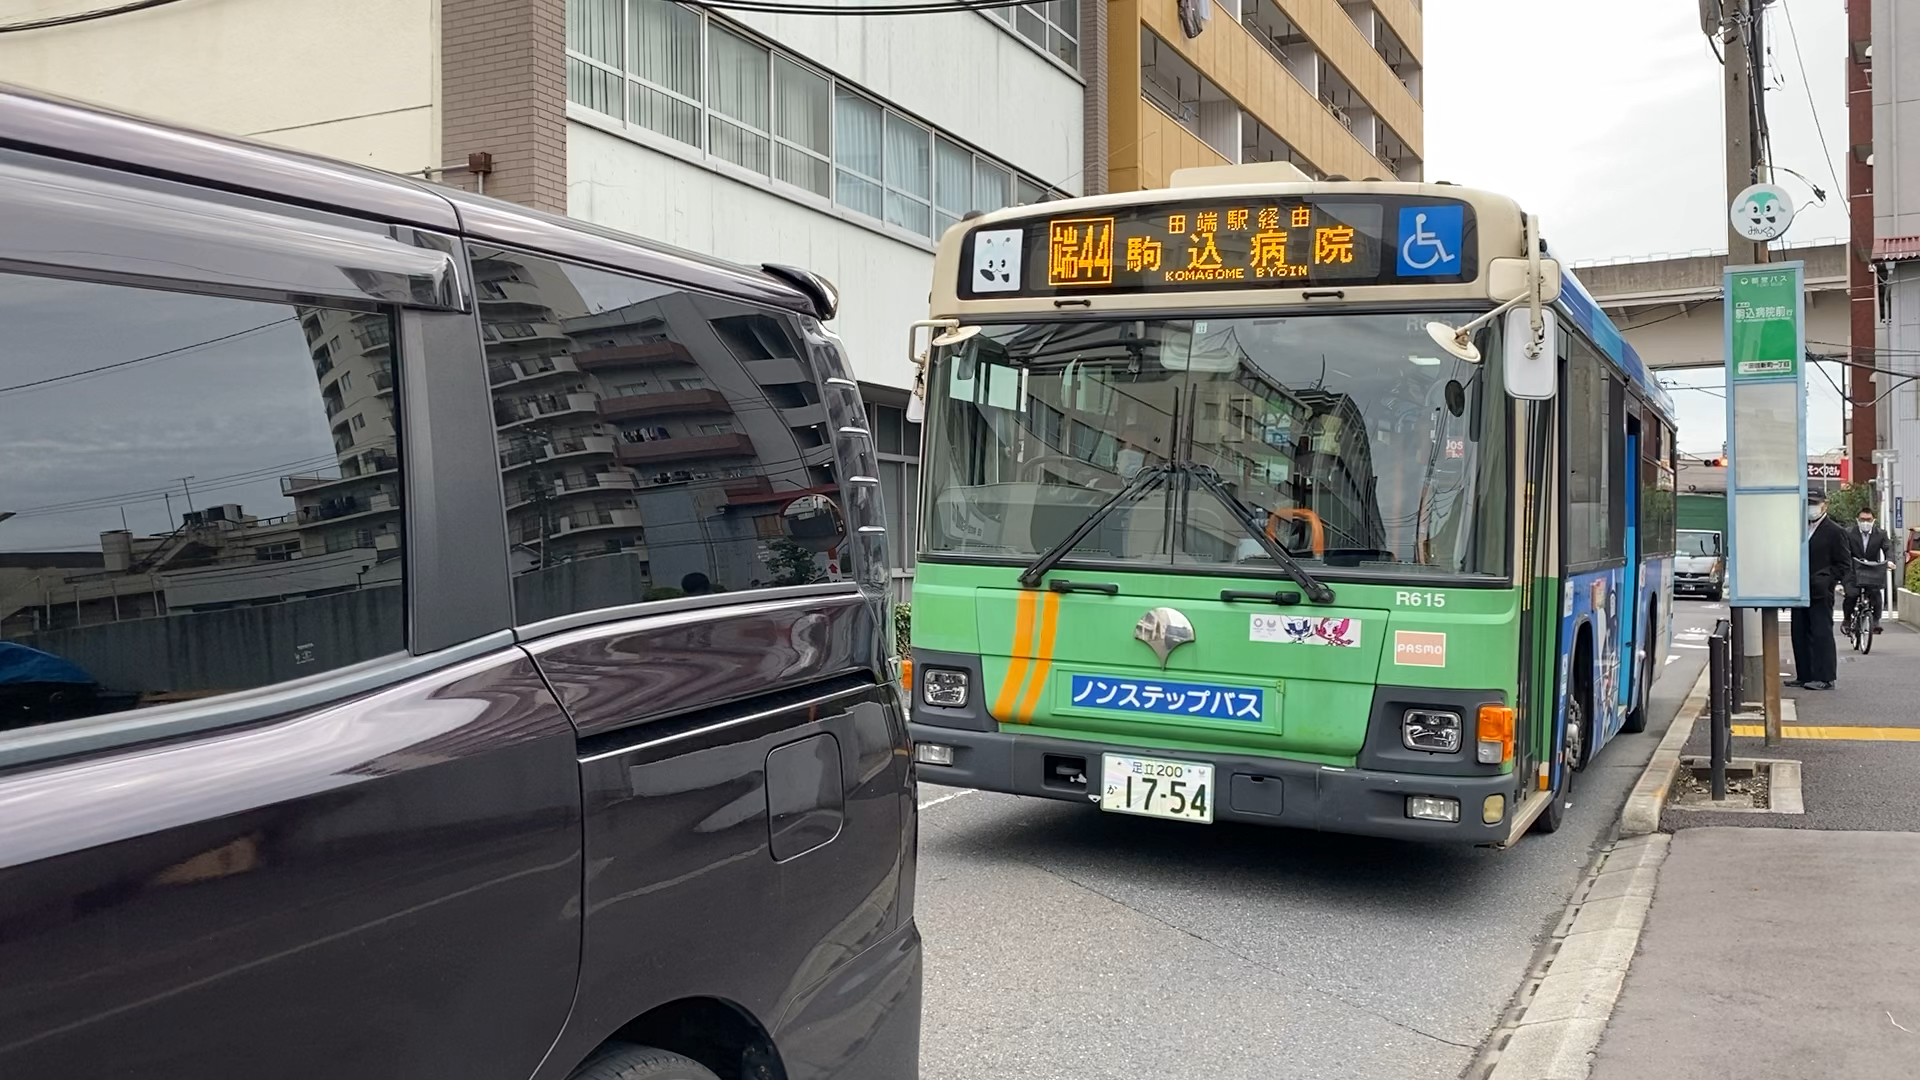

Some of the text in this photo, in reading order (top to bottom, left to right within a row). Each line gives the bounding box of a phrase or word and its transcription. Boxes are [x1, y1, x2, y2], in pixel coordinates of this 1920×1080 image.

[1169, 206, 1310, 234] 田端駅経由
[1747, 225, 1777, 238] みんくる
[1052, 224, 1111, 279] 端44
[1127, 225, 1354, 272] 駒込病院
[1165, 268, 1244, 281] KOMAGOME
[1396, 591, 1445, 607] R615
[1397, 643, 1443, 654] PASMO
[1073, 680, 1261, 718] ノンステップバス
[1106, 775, 1207, 817] か 17-54
